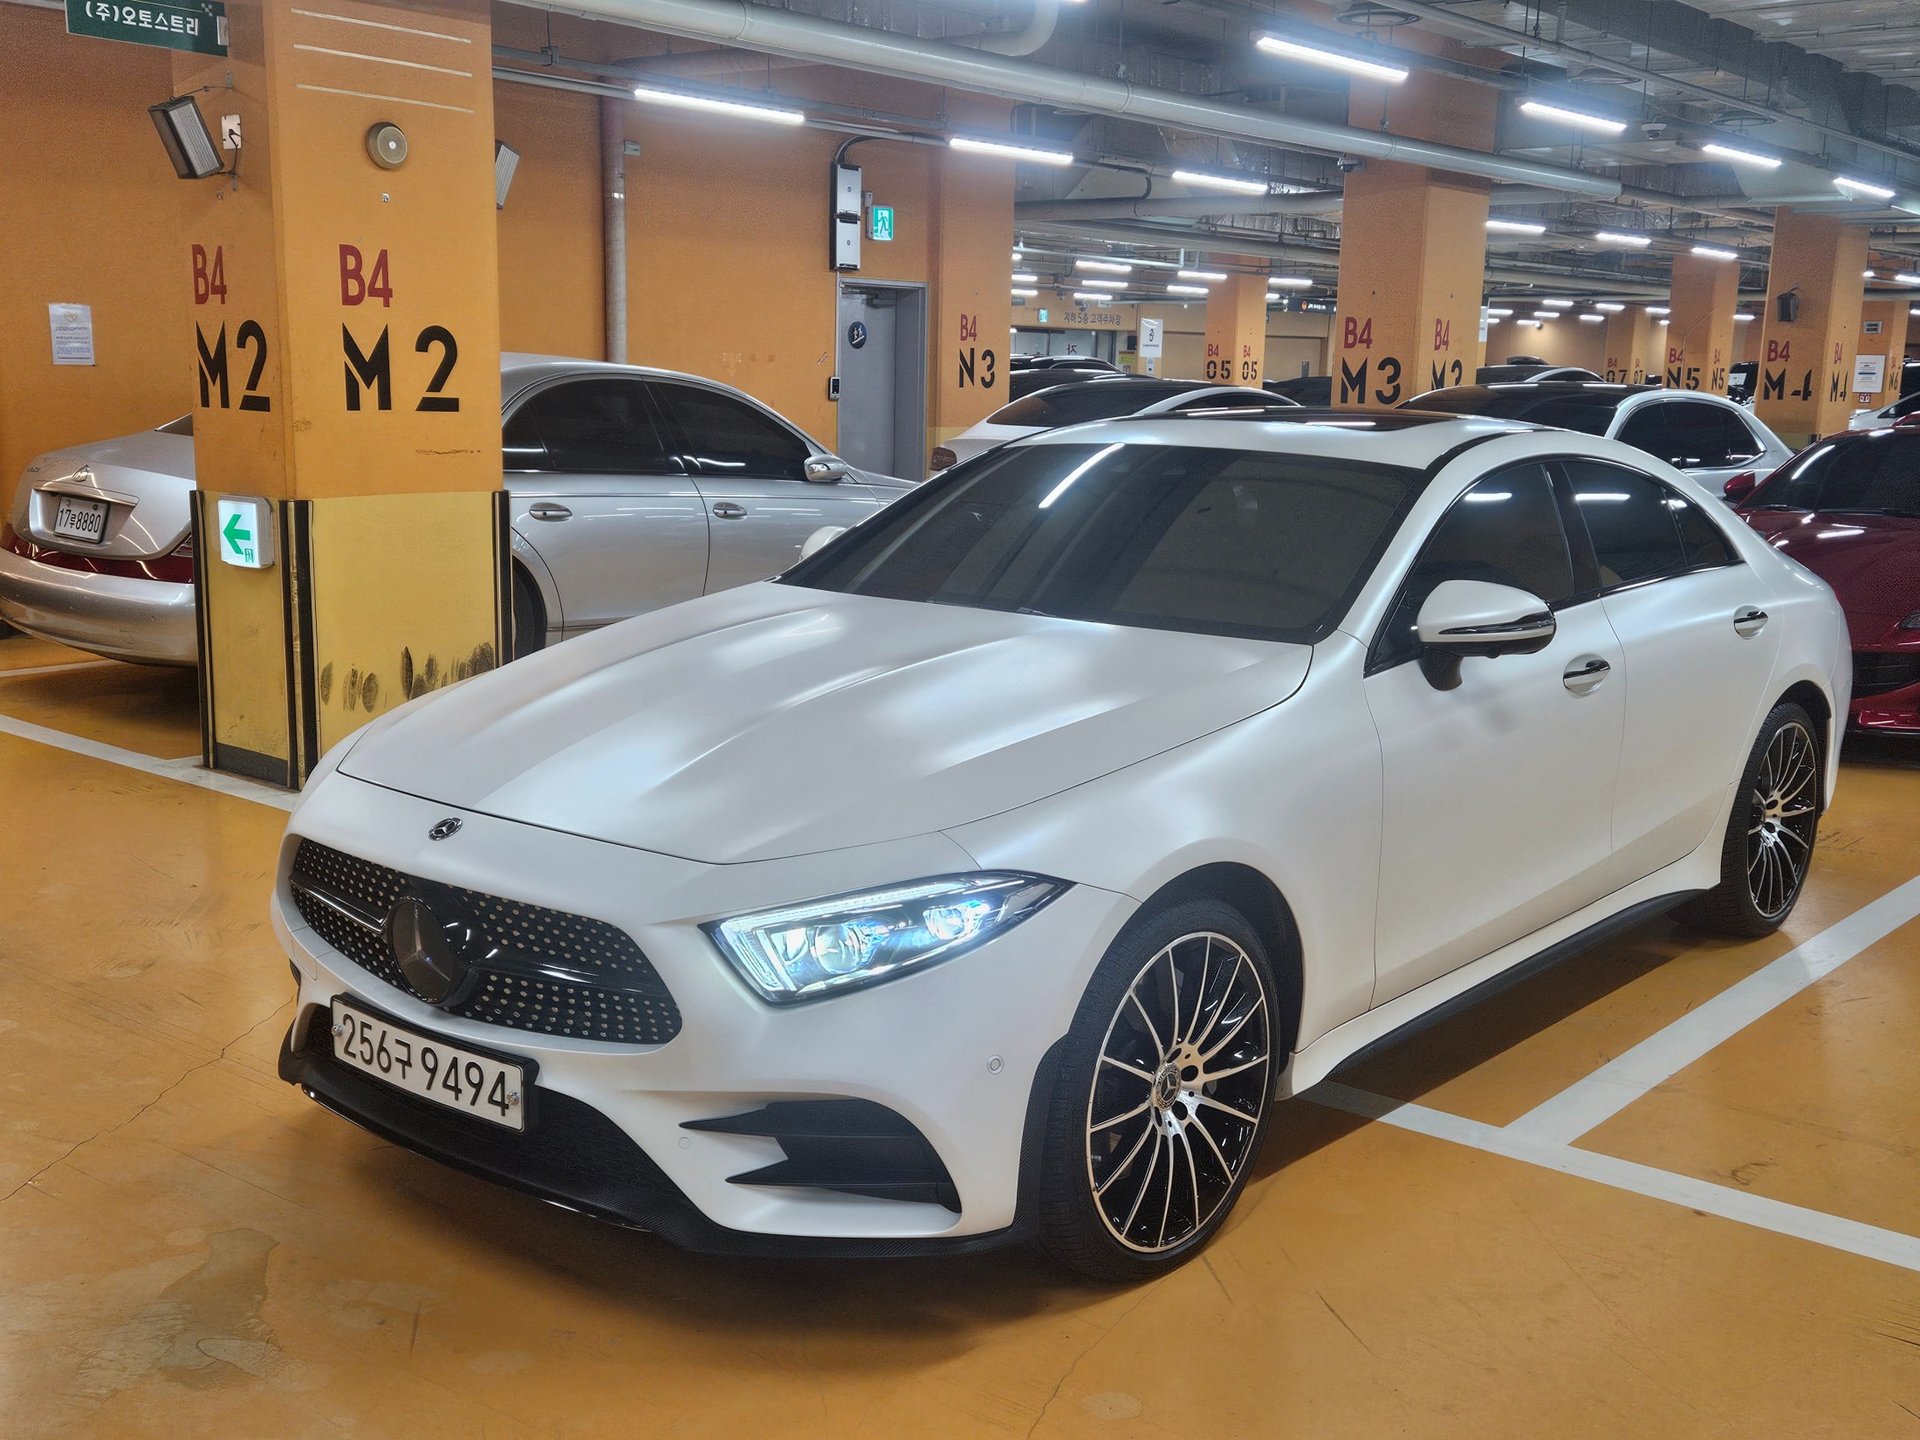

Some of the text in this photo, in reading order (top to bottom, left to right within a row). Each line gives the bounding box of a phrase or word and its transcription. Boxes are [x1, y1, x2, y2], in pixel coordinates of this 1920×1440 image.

[85, 1, 199, 36] (주)오토스트리
[192, 243, 227, 305] B4
[339, 243, 393, 307] B4
[960, 313, 978, 342] B4
[1343, 316, 1373, 349] B4
[1434, 318, 1451, 351] B4
[1207, 343, 1219, 357] B4
[1607, 357, 1617, 368] B4
[1668, 347, 1685, 364] B4
[1767, 340, 1790, 362] B4
[1834, 342, 1843, 365] B4
[195, 319, 270, 412] M2
[959, 347, 995, 389] N3
[1666, 367, 1701, 391] N5
[1711, 367, 1725, 391] N5
[1340, 356, 1401, 405] M3
[58, 509, 101, 534] 17루8880
